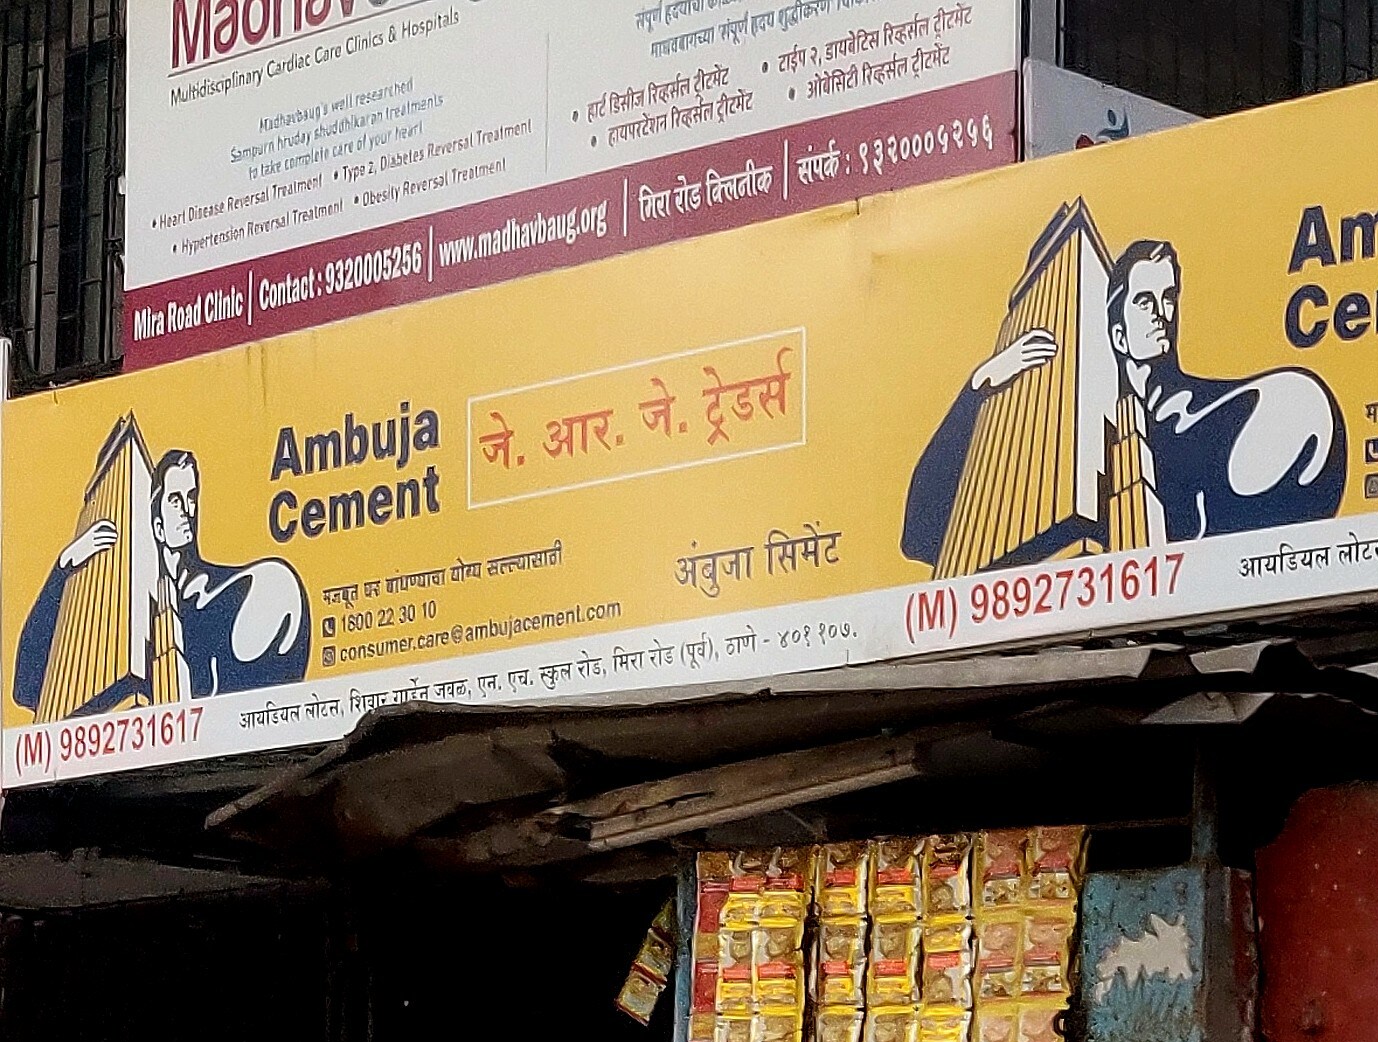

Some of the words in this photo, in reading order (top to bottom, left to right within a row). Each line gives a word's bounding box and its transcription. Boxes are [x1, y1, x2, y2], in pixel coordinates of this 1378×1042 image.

[171, 69, 264, 107] Multidisciplinary
[266, 53, 311, 78] Cardiac
[314, 46, 342, 64] Care
[345, 34, 384, 55] Clinics
[388, 25, 397, 43] &
[401, 7, 459, 39] Hospitals
[331, 93, 353, 112] well
[355, 77, 414, 107] researched
[385, 92, 444, 119] treatments
[260, 159, 281, 176] take
[284, 148, 330, 171] complete
[332, 142, 354, 158] care
[356, 133, 367, 150] of
[368, 130, 391, 151] your
[395, 119, 423, 141] heart
[342, 163, 365, 184] Type
[380, 149, 424, 172] Diabetes
[427, 135, 474, 160] Reversal
[477, 118, 533, 150] Treatment
[796, 139, 841, 185] संपर्क
[159, 210, 186, 231] Heart
[189, 201, 224, 222] Disease
[227, 188, 269, 211] Reversal
[272, 173, 322, 200] Treatment
[362, 184, 400, 207] Obesity
[402, 172, 449, 197] Reversal
[451, 157, 507, 185] Treatment
[674, 175, 702, 213] रोड
[181, 227, 245, 256] Hypertension
[247, 211, 289, 237] Reversal
[292, 198, 343, 226] Treatment
[438, 200, 608, 268] www.madhavbaug.org
[325, 242, 422, 296] 9320005256
[133, 305, 165, 341] Mira
[167, 295, 201, 334] Road
[204, 286, 244, 325] Clinic
[479, 411, 526, 472] जे.
[541, 409, 625, 460] आर.
[638, 379, 688, 437] जे.
[703, 346, 795, 446] ट्रेडर्स
[270, 402, 440, 481] Ambuja
[269, 465, 441, 544] Cement
[674, 539, 753, 602] अंबुजा
[765, 522, 843, 578] सिमेंट
[1238, 540, 1330, 579] आयडियल
[341, 609, 374, 633] 1800
[377, 606, 395, 628] 22
[399, 603, 416, 624] 30
[421, 599, 438, 620] 10
[904, 586, 958, 643] (M)
[970, 552, 1186, 625] 9892731617
[340, 600, 622, 663] consumer.care@ambujacement.com
[577, 648, 607, 679] रोड,
[612, 645, 645, 673] मिरा
[648, 638, 675, 665] रोड
[725, 624, 757, 655] ठाणे
[14, 736, 54, 777] (M)
[59, 708, 205, 764] 9892731617
